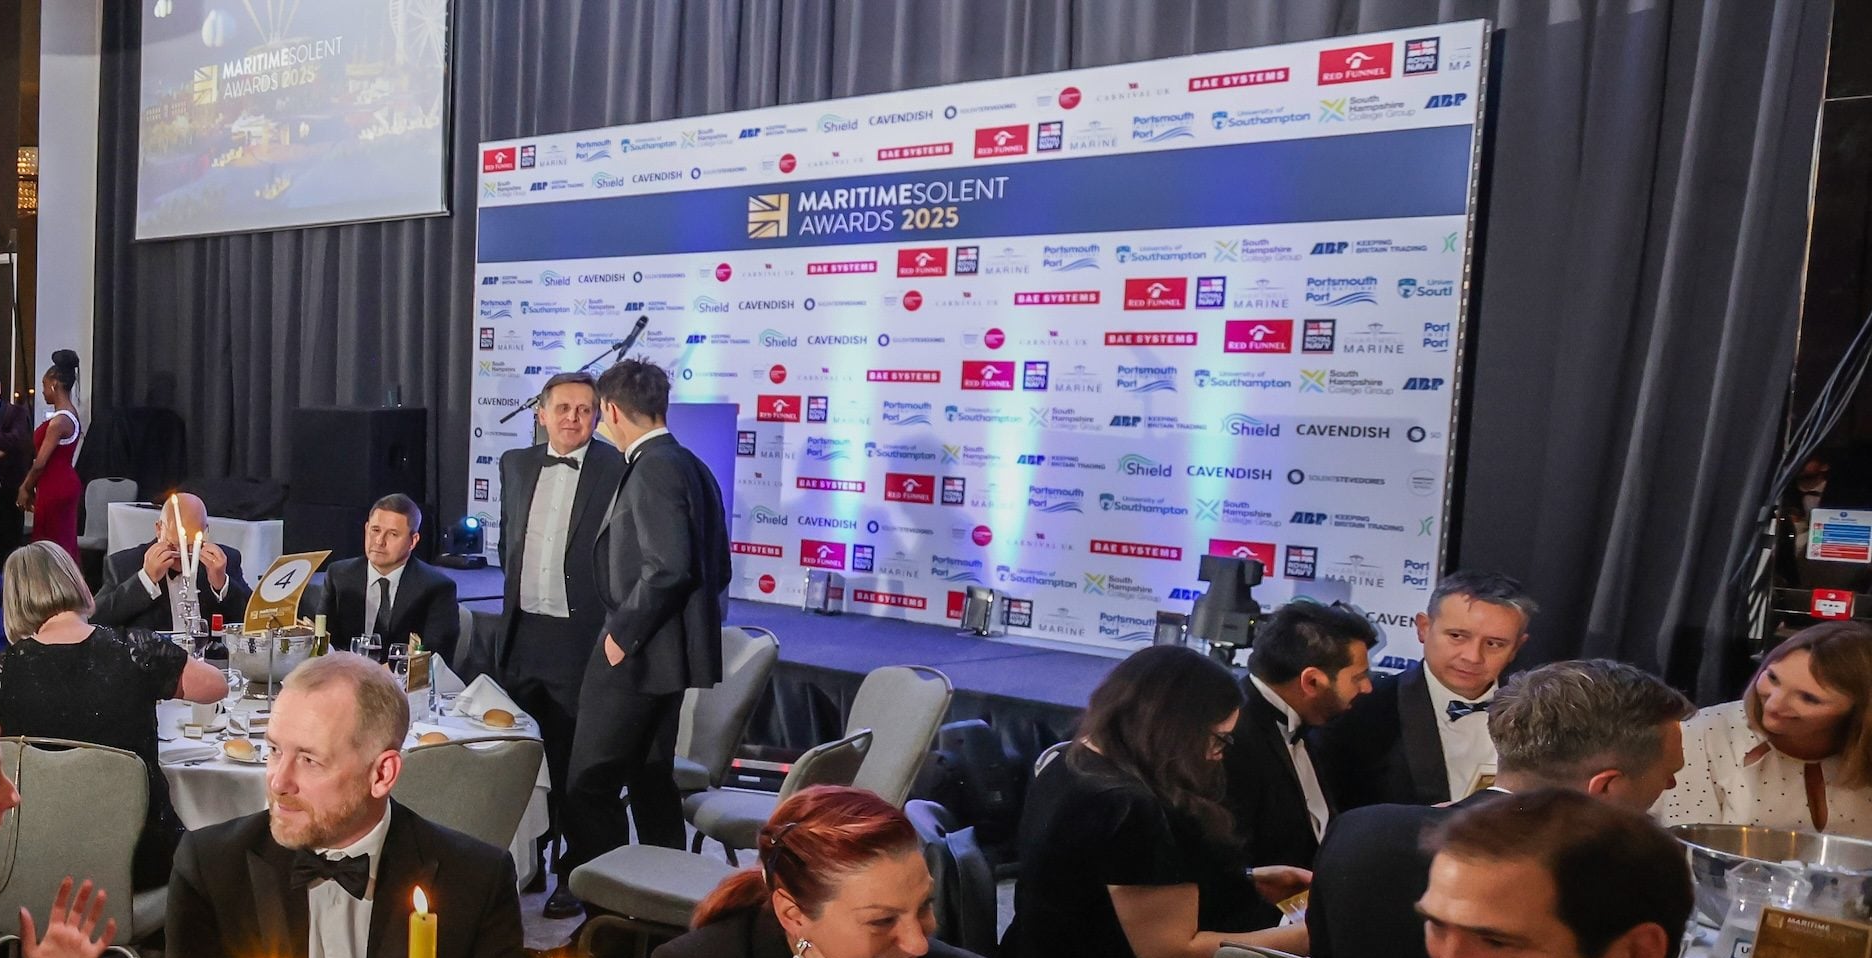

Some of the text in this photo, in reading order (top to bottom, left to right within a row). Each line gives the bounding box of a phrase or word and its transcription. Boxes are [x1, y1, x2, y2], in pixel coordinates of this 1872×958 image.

[223, 36, 343, 79] MARITIMESOLENT
[1323, 67, 1387, 81] RED FUNNEL
[224, 67, 316, 99] AWARDS 2025
[1193, 71, 1286, 89] BAE SYSTEMS
[1350, 95, 1379, 104] South
[1425, 93, 1468, 110] ABP
[1349, 102, 1404, 112] Hampshire
[869, 110, 933, 126] CAVENDISH
[1133, 111, 1195, 124] Portsmouth
[1229, 112, 1310, 127] Southampton
[824, 119, 858, 133] Shield
[739, 128, 761, 139] ABP
[1133, 130, 1153, 139] Port
[576, 140, 611, 148] Portsmouth
[1070, 138, 1118, 150] MARINE
[903, 144, 950, 157] SYSTEMS
[632, 170, 682, 183] CAVENDISH
[531, 182, 548, 191] ABP
[597, 177, 624, 188] Shield
[797, 176, 1009, 212] MARITIMESOLENT
[798, 206, 960, 236] AWARDS 2025
[1044, 244, 1100, 254] Portsmouth
[1242, 246, 1291, 254] Hampshire
[1310, 242, 1349, 255] ABP
[1131, 248, 1207, 262] Southampton
[810, 263, 874, 273] BAE SYSTEMS
[1043, 259, 1062, 267] Port
[986, 266, 1029, 274] MARINE
[482, 277, 498, 285] ABP
[545, 273, 570, 286] Shield
[578, 274, 625, 283] CAVENDISH
[1307, 277, 1377, 287] Portsmouth
[1018, 293, 1096, 303] BAE SYSTEMS
[1148, 298, 1182, 306] FUNNEL
[1306, 292, 1330, 302] Port
[625, 302, 644, 311] ABP
[699, 303, 729, 312] Shield
[738, 301, 794, 310] CAVENDISH
[1234, 300, 1288, 309] MARINE
[686, 335, 706, 344] ABP
[765, 337, 797, 347] Shield
[807, 335, 867, 345] CAVENDISH
[1108, 335, 1195, 345] BAE SYSTEMS
[1228, 341, 1286, 350] RED FUNNEL
[1344, 345, 1404, 354] MARINE
[524, 366, 541, 374] ABP
[1118, 365, 1177, 375] Portsmouth
[869, 372, 937, 381] BAE SYSTEMS
[965, 379, 1010, 388] RED FUNNEL
[1117, 379, 1137, 388] Port
[1211, 378, 1291, 389] Southampton
[1330, 378, 1382, 387] Hampshire
[1402, 378, 1444, 390] ABP
[1056, 383, 1102, 393] MARINE
[478, 398, 519, 406] CAVENDISH
[884, 401, 931, 409] Portsmouth
[1109, 416, 1141, 427] ABP
[1230, 422, 1280, 437] Shield
[1297, 424, 1390, 439] CAVENDISH
[761, 451, 795, 460] MARINE
[877, 449, 935, 461] Southampton
[1017, 455, 1046, 465] ABP
[476, 456, 493, 465] ABP
[1127, 463, 1172, 477] Shield
[1187, 465, 1272, 481] CAVENDISH
[799, 479, 862, 491] BAE SYSTEMS
[1029, 486, 1084, 497] Portsmouth
[1029, 499, 1047, 507] Port
[1115, 501, 1188, 516] Southampton
[1223, 508, 1272, 518] Hampshire
[480, 516, 500, 528] Shiel
[756, 513, 788, 525] Shield
[798, 516, 857, 529] CAVENDISH
[1290, 512, 1328, 525] ABP
[741, 544, 780, 555] SYSTEMS
[1094, 543, 1178, 558] BAE SYSTEMS
[932, 555, 983, 567] Portsmouth
[880, 568, 919, 578] MARINE
[931, 568, 948, 576] Port
[1287, 568, 1313, 576] NAVY
[274, 569, 297, 589] 4
[1010, 573, 1077, 589] Southampton
[1325, 574, 1384, 588] MARINE
[857, 591, 923, 608] BAE SYSTEMS
[1366, 612, 1416, 628] CAVEN
[1039, 624, 1085, 636] MARINE
[1100, 626, 1119, 635] Port
[1787, 917, 1830, 930] MARITIME
